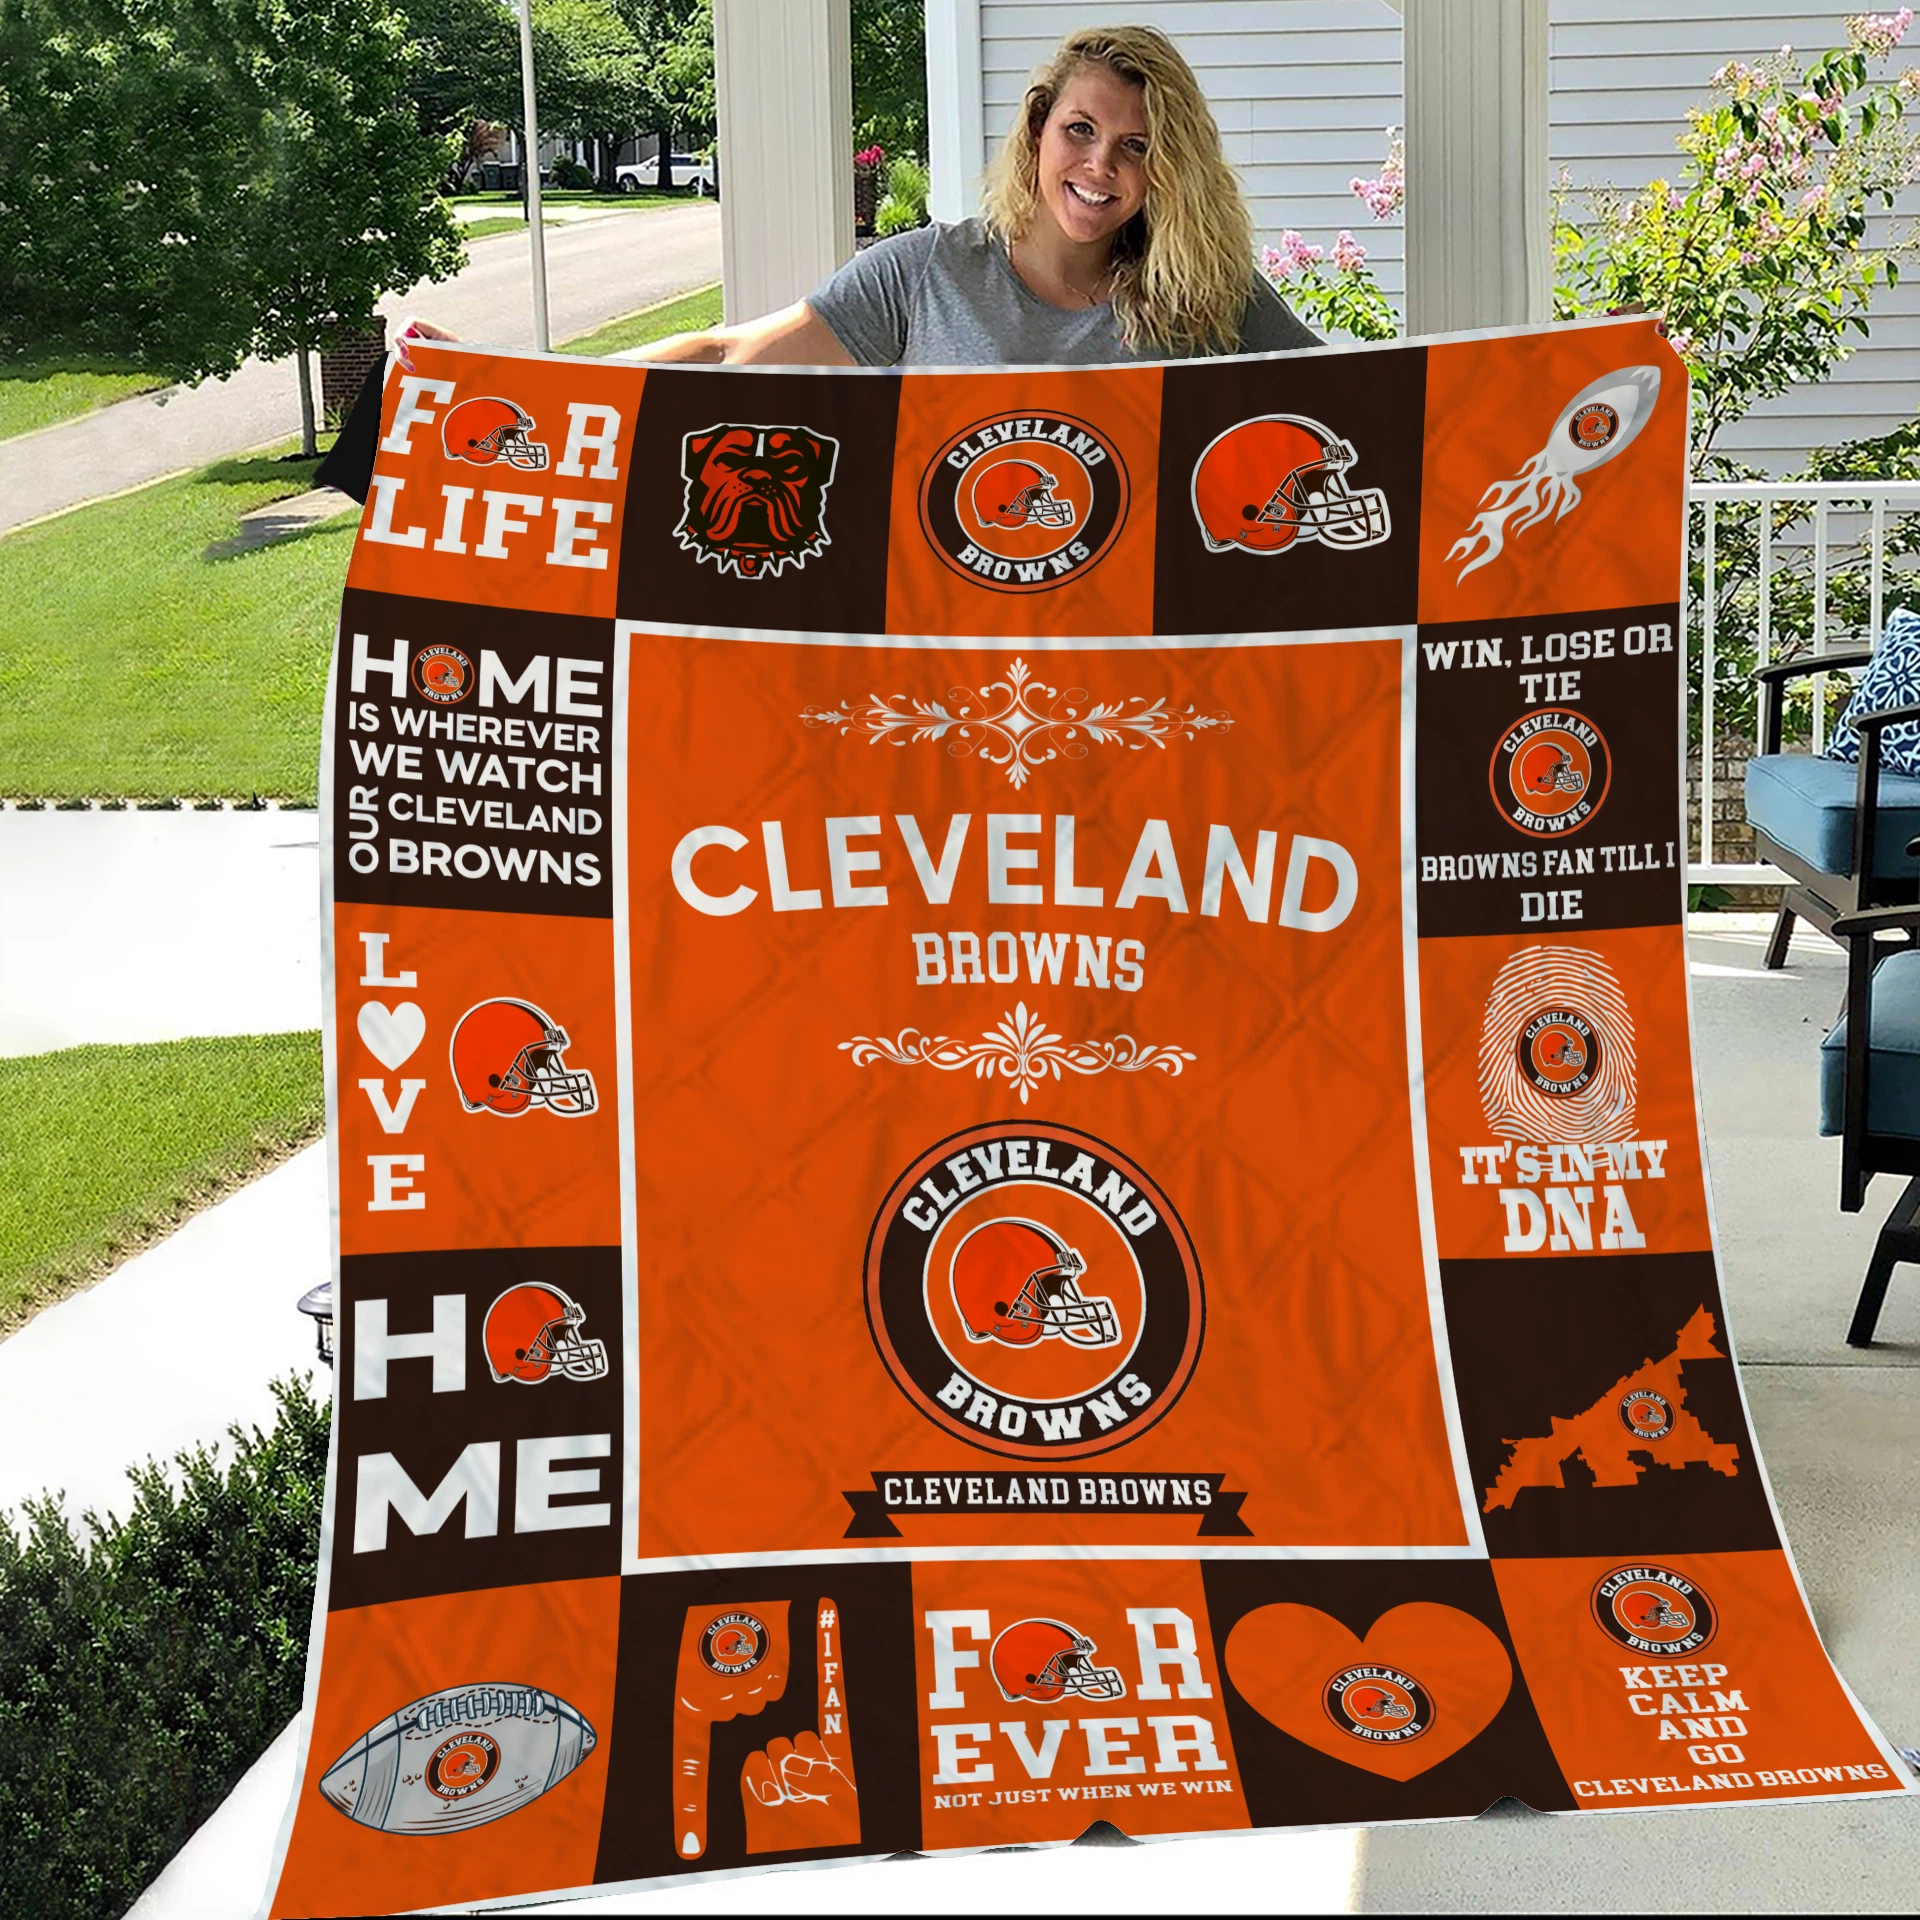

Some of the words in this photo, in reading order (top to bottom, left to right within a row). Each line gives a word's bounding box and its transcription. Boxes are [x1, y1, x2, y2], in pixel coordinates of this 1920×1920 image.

[947, 420, 1106, 468] CLEVELAND
[363, 474, 613, 569] LIFE
[957, 542, 1090, 582] BROWNS
[419, 647, 468, 667] CLEVELAND
[1422, 638, 1512, 670] WIN,
[1521, 628, 1615, 664] LOSE
[1624, 623, 1673, 656] OR
[423, 686, 463, 701] BROWNS
[1519, 671, 1581, 703] TIE
[348, 701, 380, 732] IS
[390, 705, 600, 754] WHEREVER
[1503, 714, 1598, 753] CLEVELAND
[349, 739, 423, 780] WE
[435, 749, 601, 796] WATCH
[388, 792, 602, 835] CLEVELAND
[1512, 801, 1591, 831] BROWNS
[349, 785, 379, 874] OUR
[389, 838, 601, 887] BROWNS
[670, 813, 1359, 933] CLEVELAND
[1421, 851, 1537, 882] BROWNS
[1543, 848, 1594, 875] FAN
[1600, 843, 1660, 872] TILL
[1666, 842, 1675, 867] I
[1520, 889, 1583, 922] DIE
[911, 931, 1146, 992] BROWNS
[1525, 1012, 1591, 1040] CLEVELAND
[1534, 1072, 1589, 1093] BROWNS
[1459, 1140, 1541, 1184] IT'S
[1549, 1143, 1595, 1182] IN
[1606, 1140, 1668, 1180] MY
[902, 1140, 1157, 1237] CLEVELAND
[1499, 1185, 1646, 1252] DNA
[936, 1372, 1152, 1441] BROWNS
[1622, 1391, 1666, 1408] CLEVELAND
[1633, 1426, 1670, 1438] BROWNS
[884, 1477, 1069, 1505] CLEVELAND
[1079, 1478, 1212, 1506] BROWNS
[1600, 1568, 1693, 1598] CLEVELAND
[707, 1615, 762, 1636] CLEVELAND
[1626, 1632, 1704, 1653] BROWNS
[711, 1658, 758, 1673] BROWNS
[1332, 1667, 1416, 1692] CLEVELAND
[1618, 1663, 1728, 1689] KEEP
[1627, 1690, 1750, 1716] CALM
[1351, 1722, 1422, 1741] BROWNS
[1658, 1715, 1748, 1740] AND
[437, 1735, 494, 1758] CLEVELAND
[930, 1715, 1228, 1785] EVER
[1686, 1743, 1746, 1765] GO
[437, 1778, 484, 1795] BROWNS
[934, 1792, 982, 1809] NOT
[988, 1788, 1051, 1805] JUST
[1057, 1784, 1132, 1801] WHEN
[1136, 1782, 1176, 1797] WE
[1181, 1780, 1233, 1794] WIN
[1573, 1772, 1755, 1797] CLEVELAND
[1754, 1763, 1889, 1787] BROWNS
